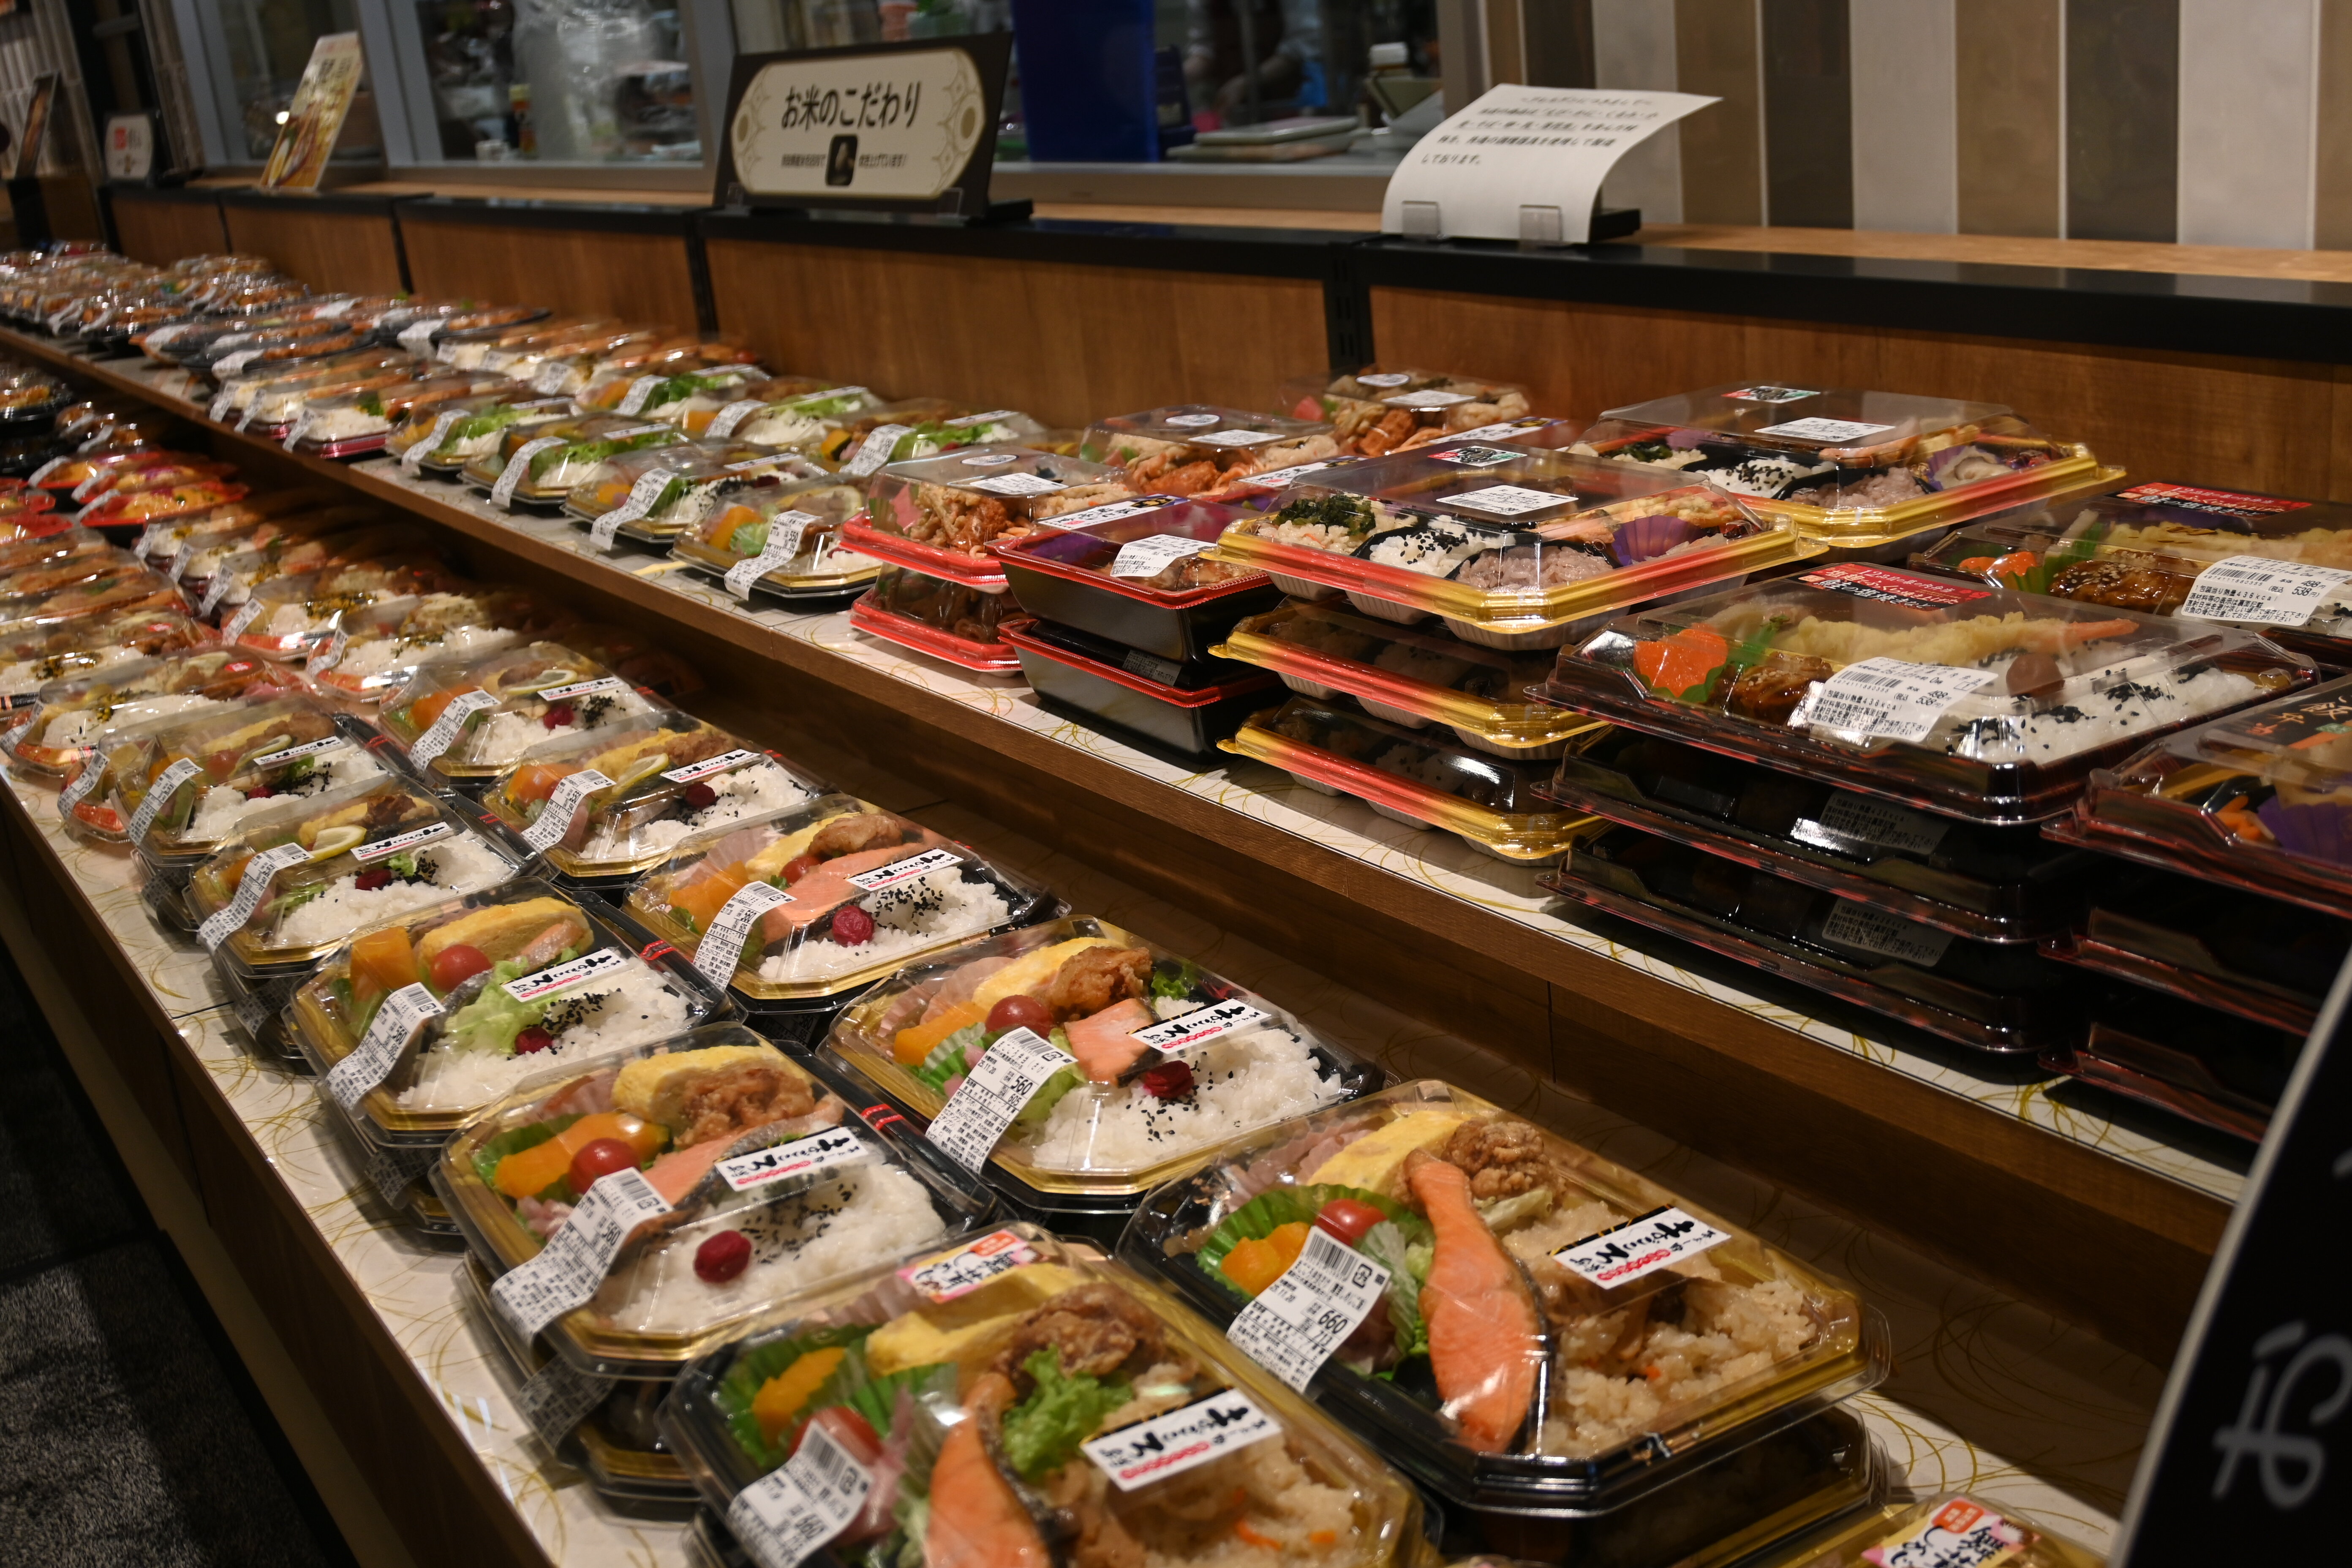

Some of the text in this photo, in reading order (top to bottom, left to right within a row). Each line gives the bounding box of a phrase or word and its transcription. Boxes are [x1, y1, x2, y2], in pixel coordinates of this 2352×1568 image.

[781, 80, 921, 131] お米のこだわり
[1421, 153, 1481, 165] しております。
[789, 531, 799, 543] 550
[2203, 575, 2263, 586] 4974111880355
[2301, 580, 2326, 589] 498円
[1814, 579, 1936, 609] 鮭の塩焼きなど
[2189, 593, 2264, 608] 原材料等の表示は裏面記載
[1817, 697, 1889, 719] 原材料等の表示は裏面記載
[569, 791, 581, 804] 550
[741, 910, 757, 923] 560
[739, 923, 748, 933] 605
[393, 1026, 409, 1045] 560
[1010, 1075, 1033, 1096] 560
[1008, 1094, 1022, 1106] 605
[601, 1222, 621, 1247] 560
[1318, 1309, 1348, 1334] 660
